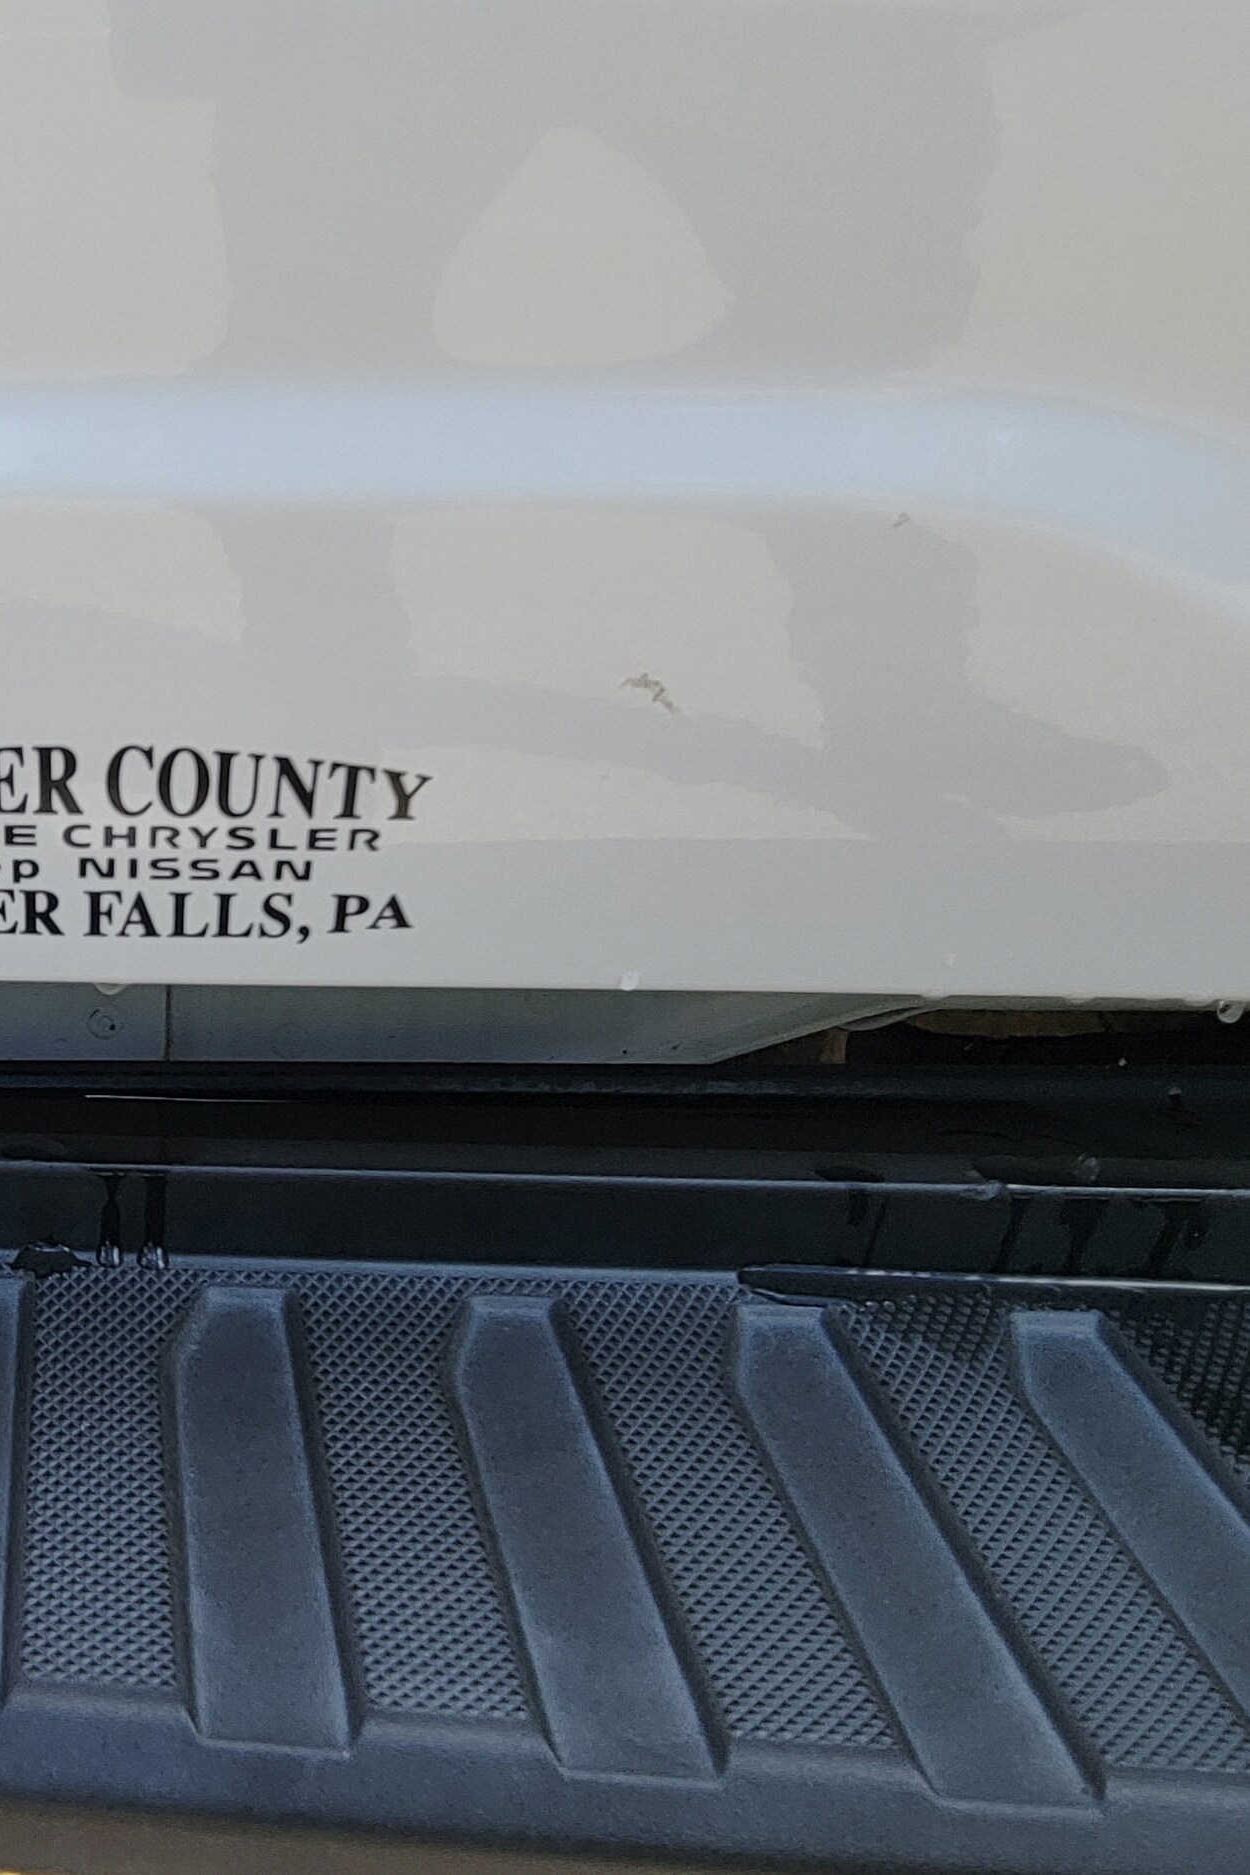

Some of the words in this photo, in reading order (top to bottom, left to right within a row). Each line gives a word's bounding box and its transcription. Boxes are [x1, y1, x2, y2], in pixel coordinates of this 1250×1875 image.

[105, 745, 432, 820] COUNTY
[62, 824, 380, 852] CHRYSLER
[78, 857, 312, 882] NISSAN
[83, 890, 311, 944] FALLS,
[327, 893, 413, 934] PA
